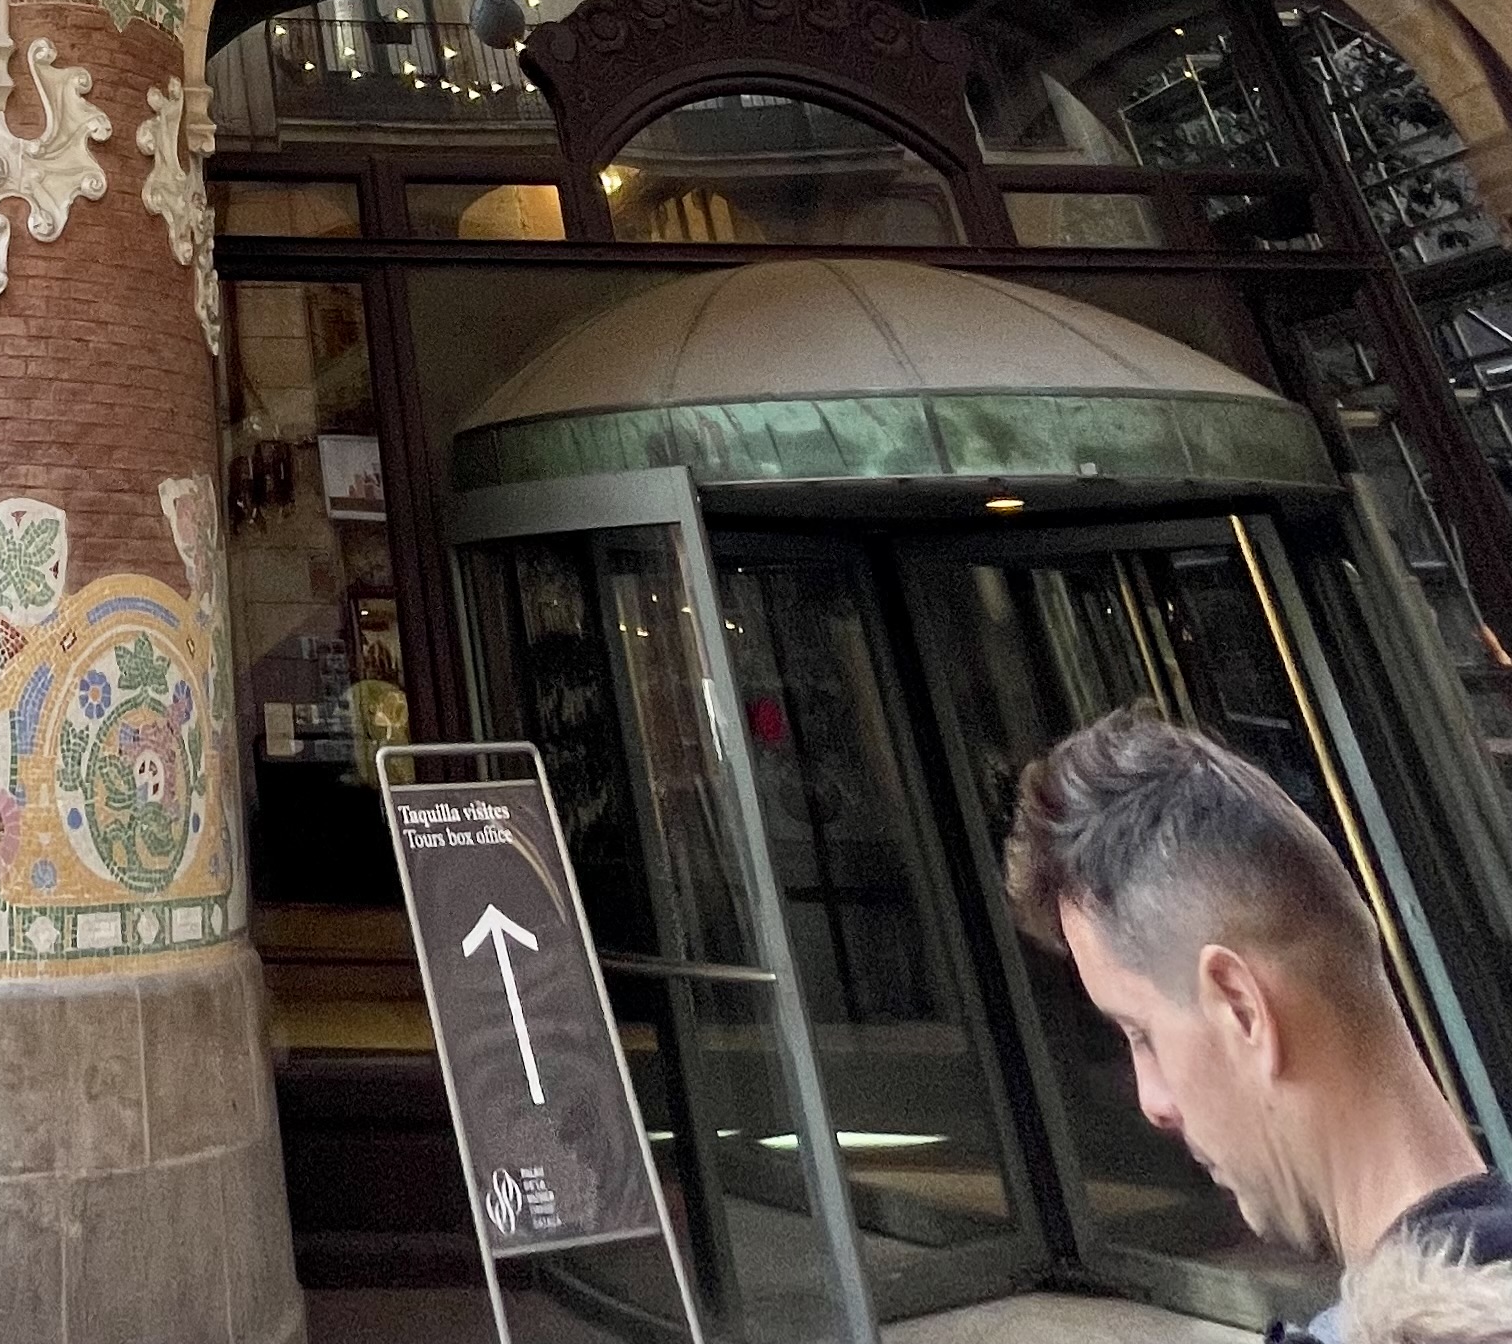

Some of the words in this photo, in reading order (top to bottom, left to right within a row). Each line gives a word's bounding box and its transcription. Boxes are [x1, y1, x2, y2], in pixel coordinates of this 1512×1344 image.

[398, 803, 461, 828] Taquilla
[463, 800, 510, 820] visites
[403, 829, 446, 849] Tours
[446, 827, 474, 847] box
[476, 825, 513, 844] office
